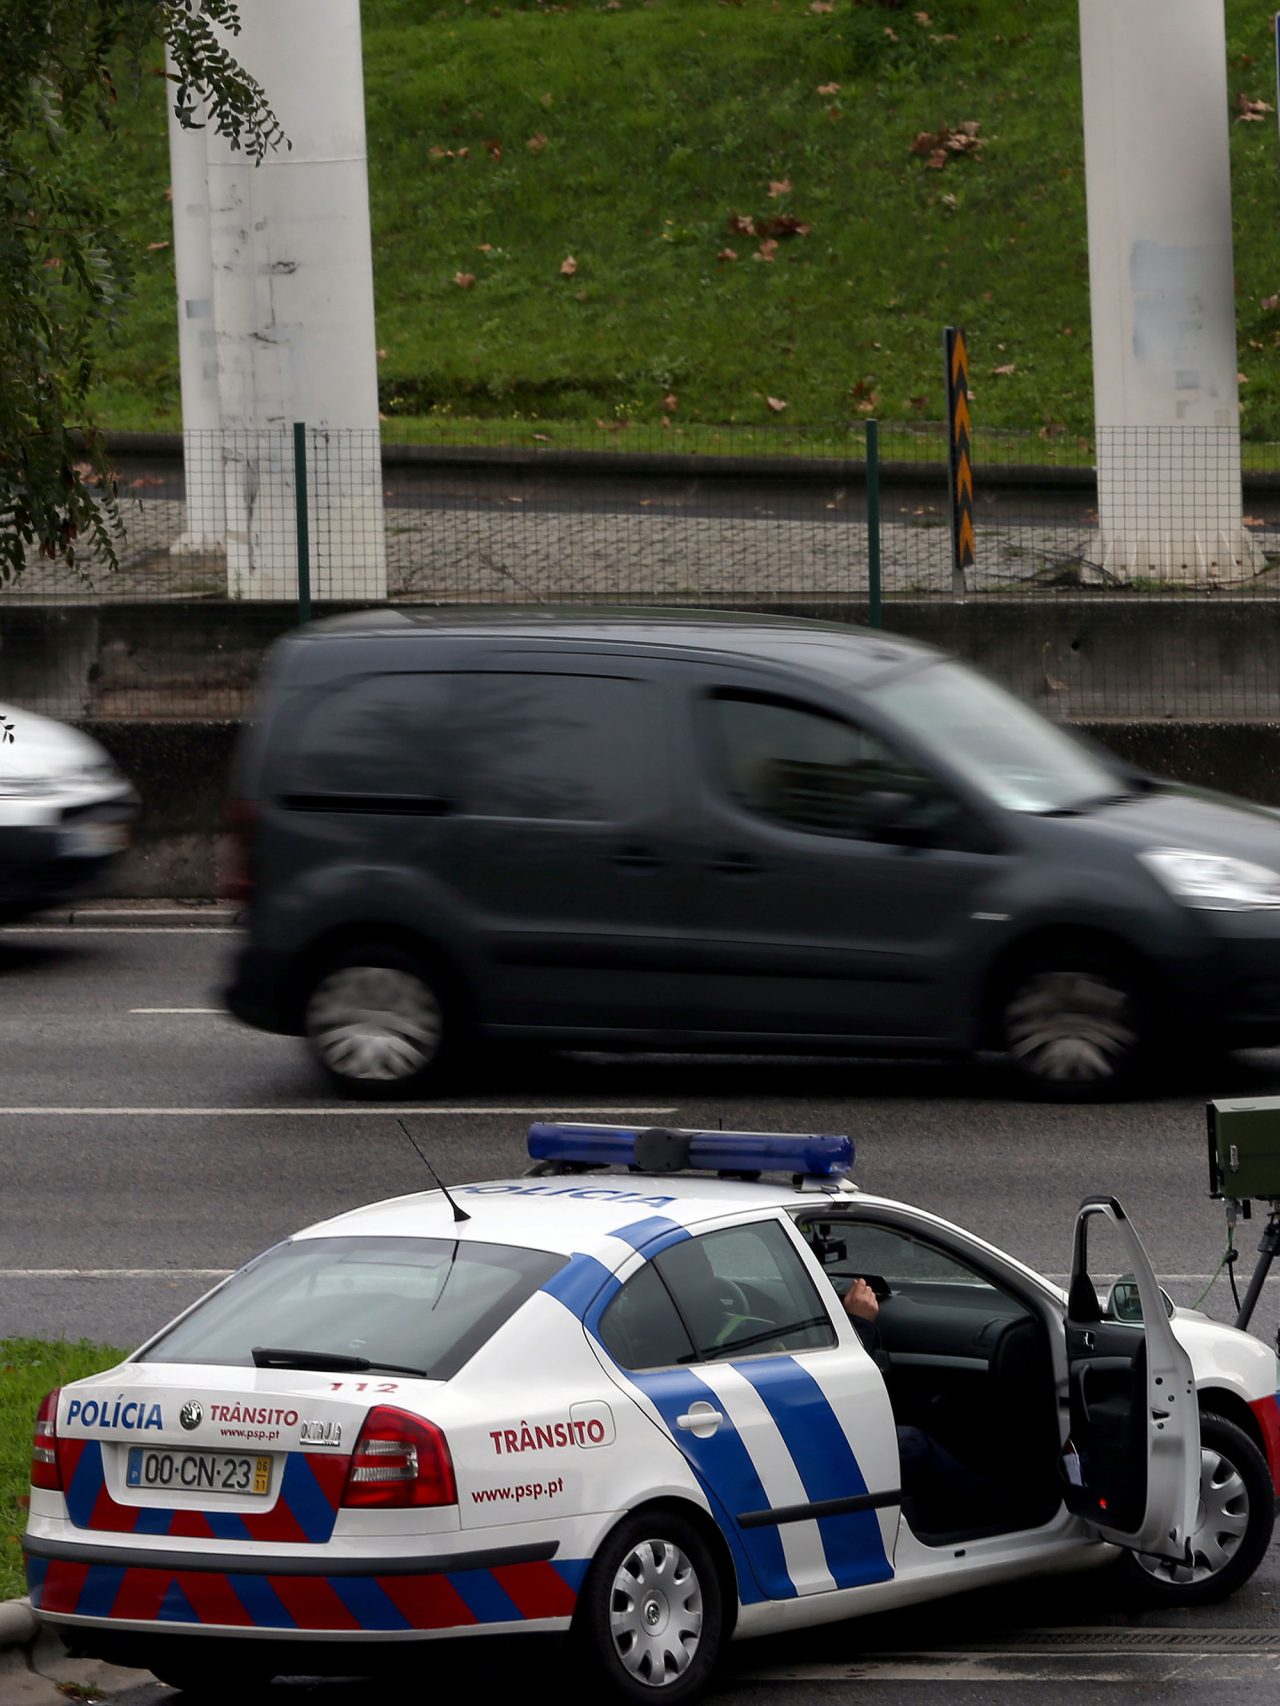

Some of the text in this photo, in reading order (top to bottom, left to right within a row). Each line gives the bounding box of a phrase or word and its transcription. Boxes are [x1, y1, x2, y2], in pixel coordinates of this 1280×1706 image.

[330, 1382, 399, 1394] 112
[66, 1394, 163, 1431] POLÍCIA
[210, 1401, 299, 1427] TRÂNSITO
[220, 1428, 280, 1440] www.psp.pt
[489, 1419, 605, 1455] TRÂNSITO
[256, 1479, 266, 1490] 11
[471, 1477, 564, 1503] www.psp.pt
